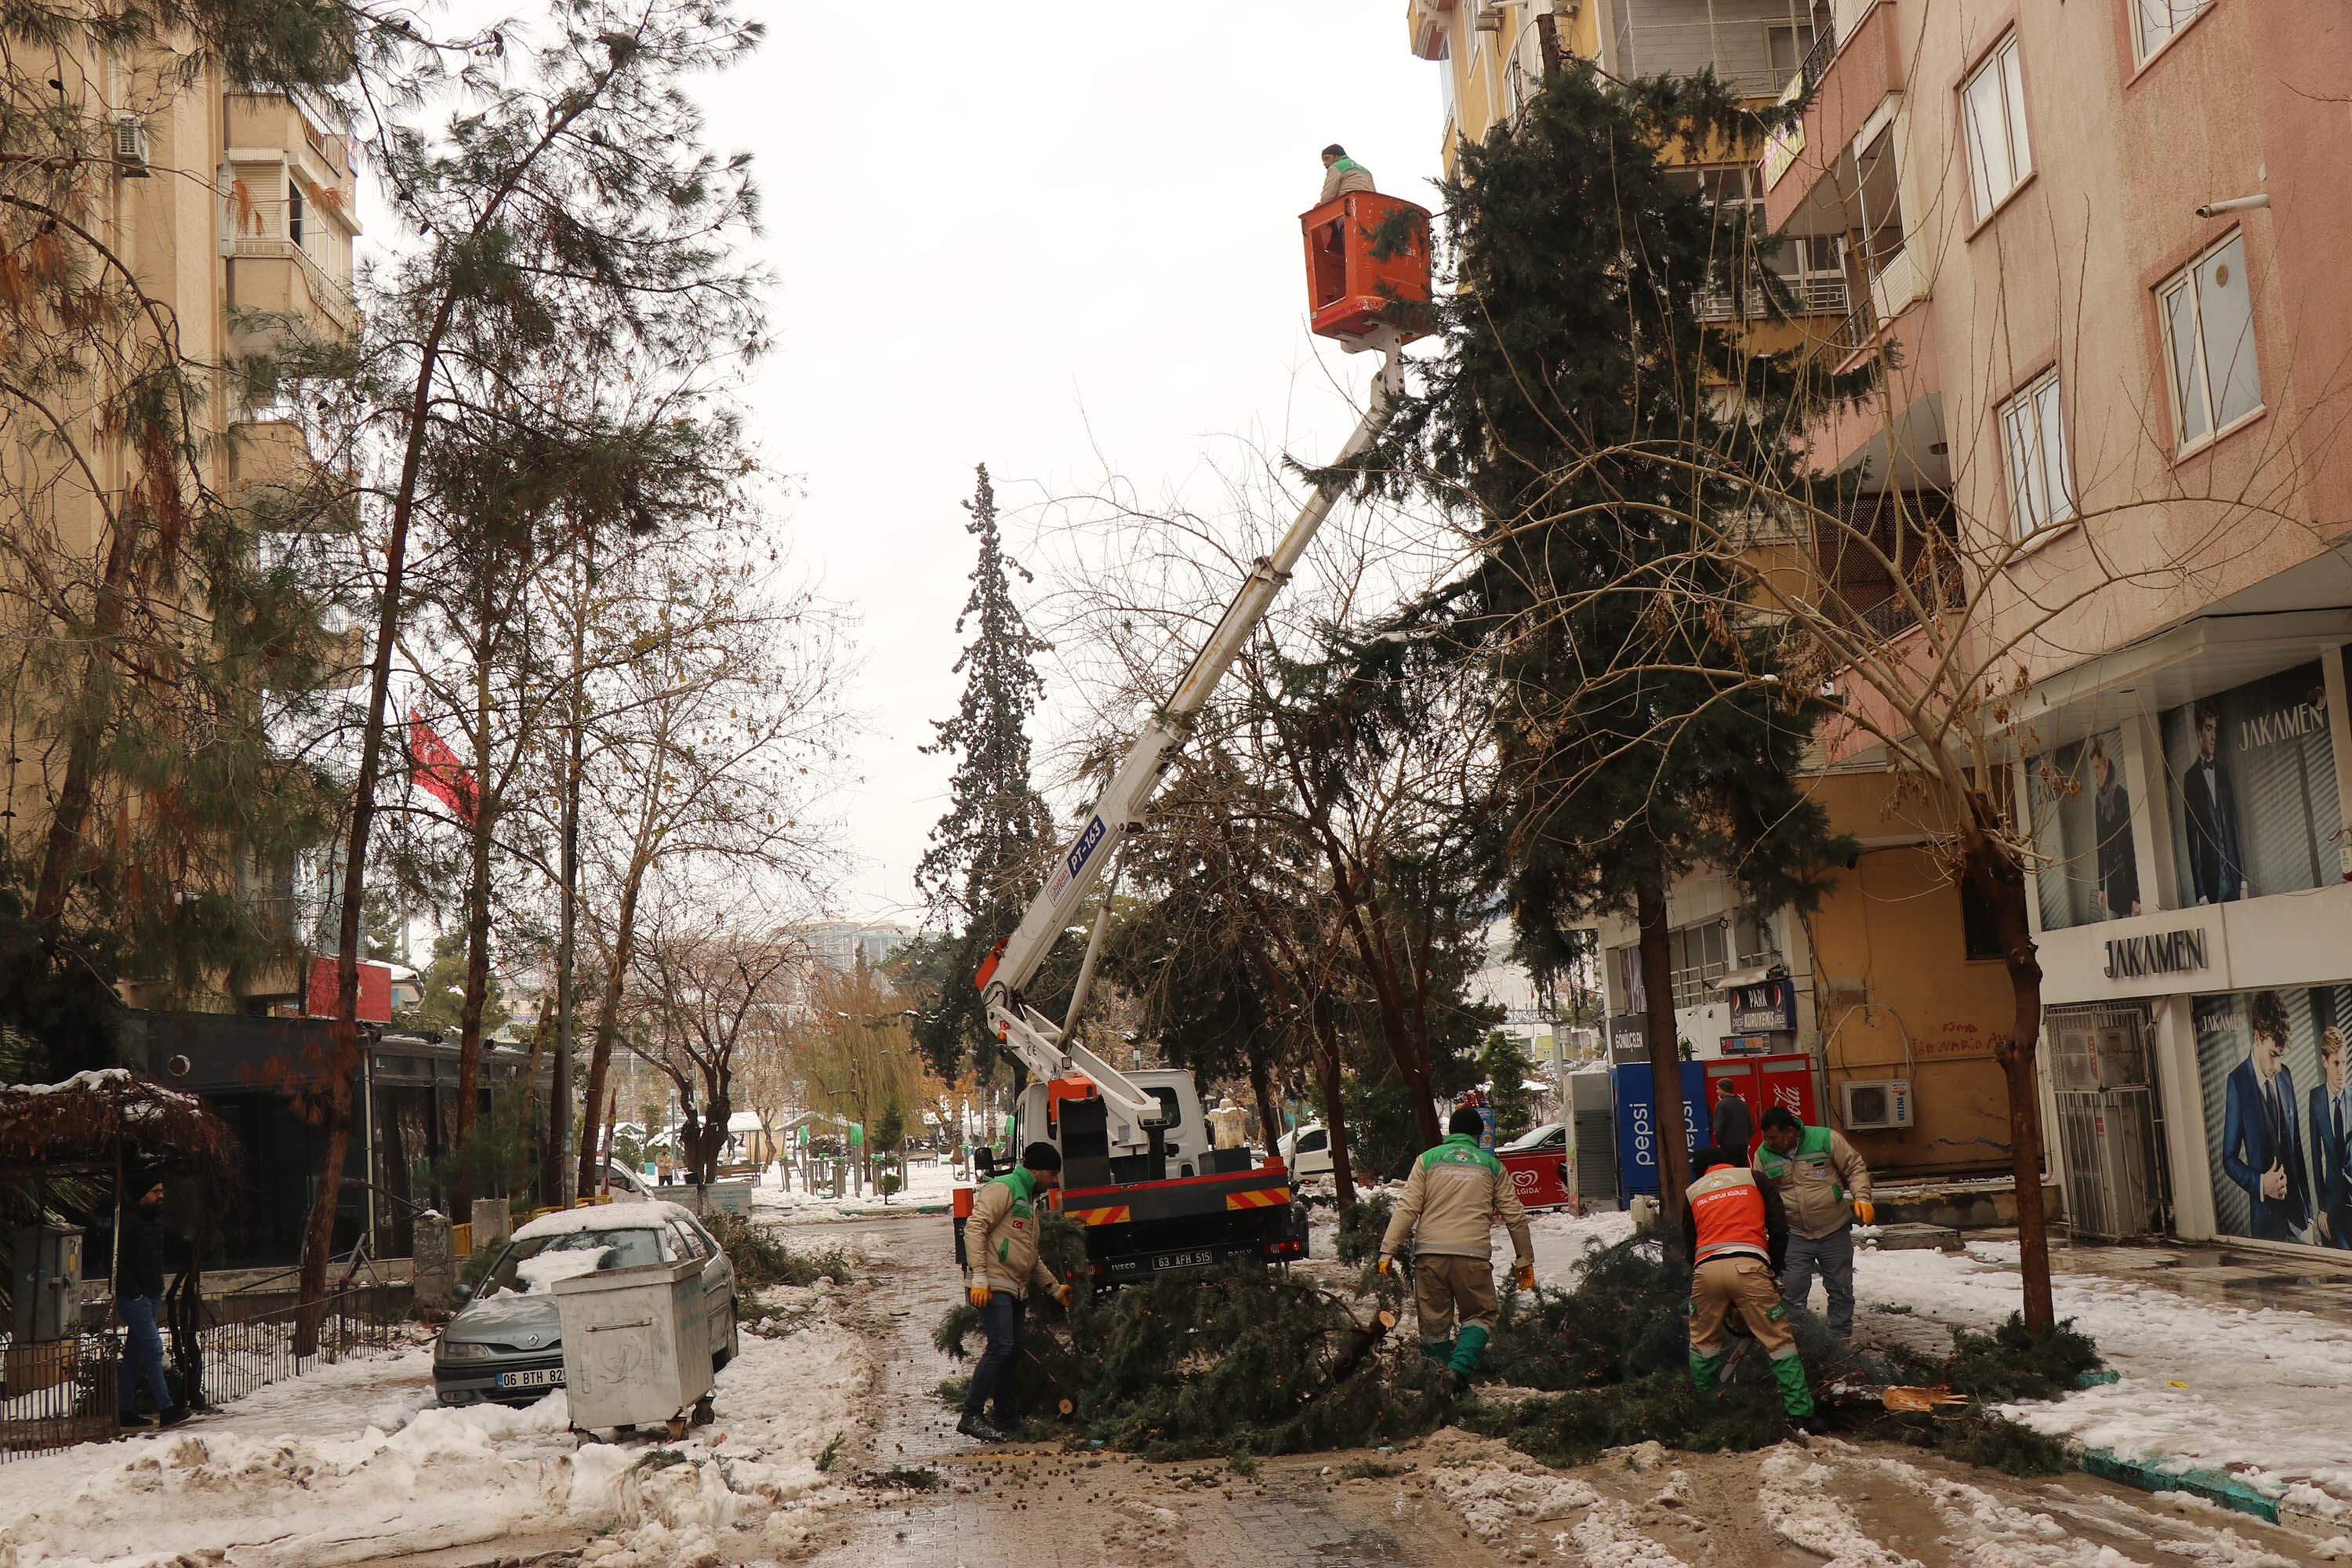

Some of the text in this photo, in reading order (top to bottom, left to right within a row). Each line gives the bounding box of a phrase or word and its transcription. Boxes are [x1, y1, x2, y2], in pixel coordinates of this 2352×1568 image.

[2239, 702, 2324, 751] JAKAMEN
[1070, 822, 1101, 871] PT-163
[2103, 928, 2209, 978] JAKAMEN
[1748, 988, 1768, 1008] PARK
[2201, 1014, 2249, 1032] JAKAMEN
[1629, 1103, 1656, 1166] pepsi
[1516, 1187, 1540, 1196] LGIDA
[1111, 1262, 1136, 1272] IVECO
[1158, 1252, 1210, 1268] 63 AFH 515
[503, 1374, 517, 1386] 06
[523, 1371, 543, 1385] BTH
